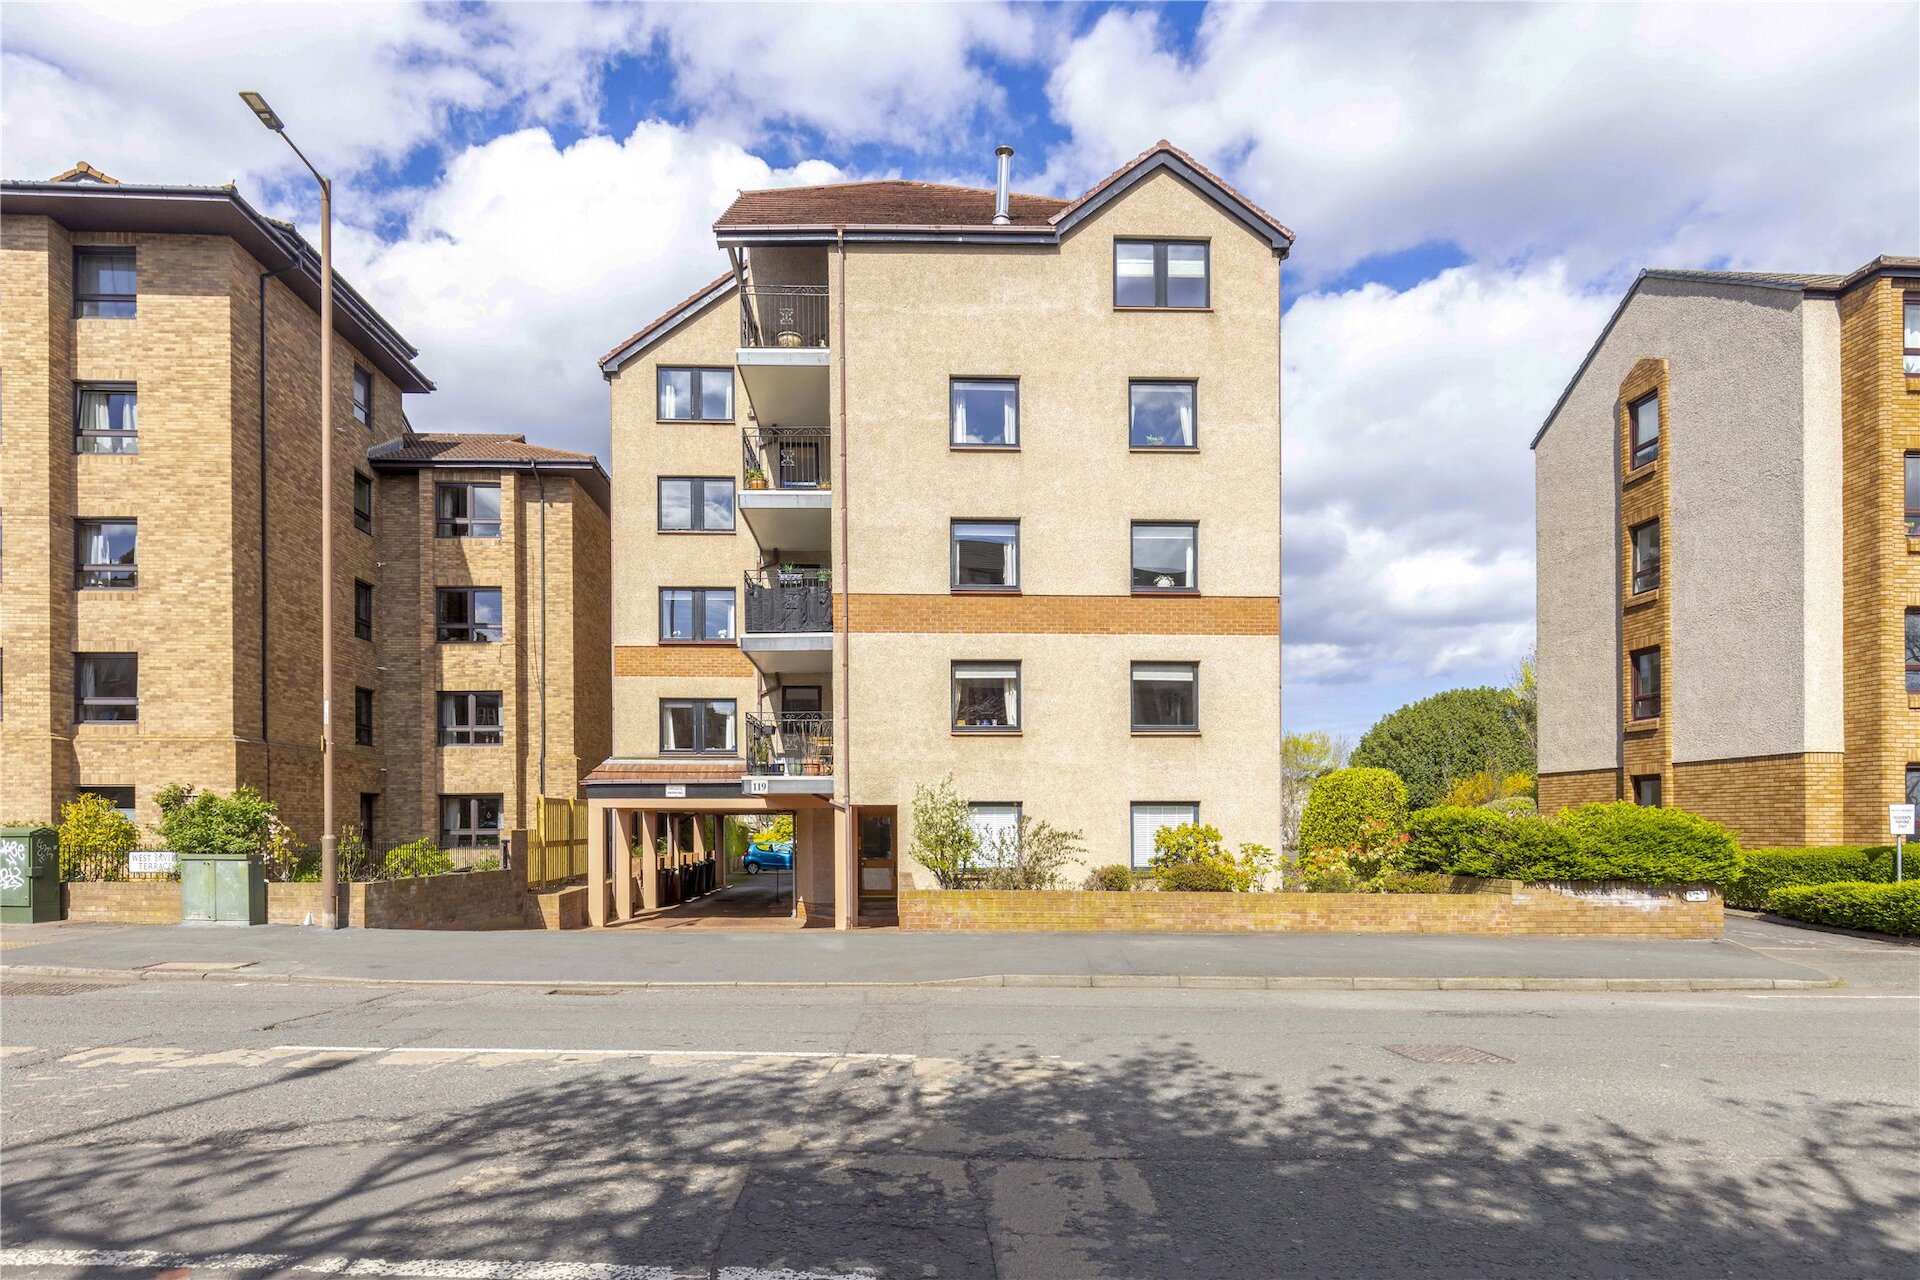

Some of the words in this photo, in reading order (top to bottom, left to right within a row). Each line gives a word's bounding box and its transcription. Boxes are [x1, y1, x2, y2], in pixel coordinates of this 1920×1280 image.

[753, 782, 767, 791] 119
[131, 854, 151, 862] WEST
[138, 863, 172, 871] TERRACE
